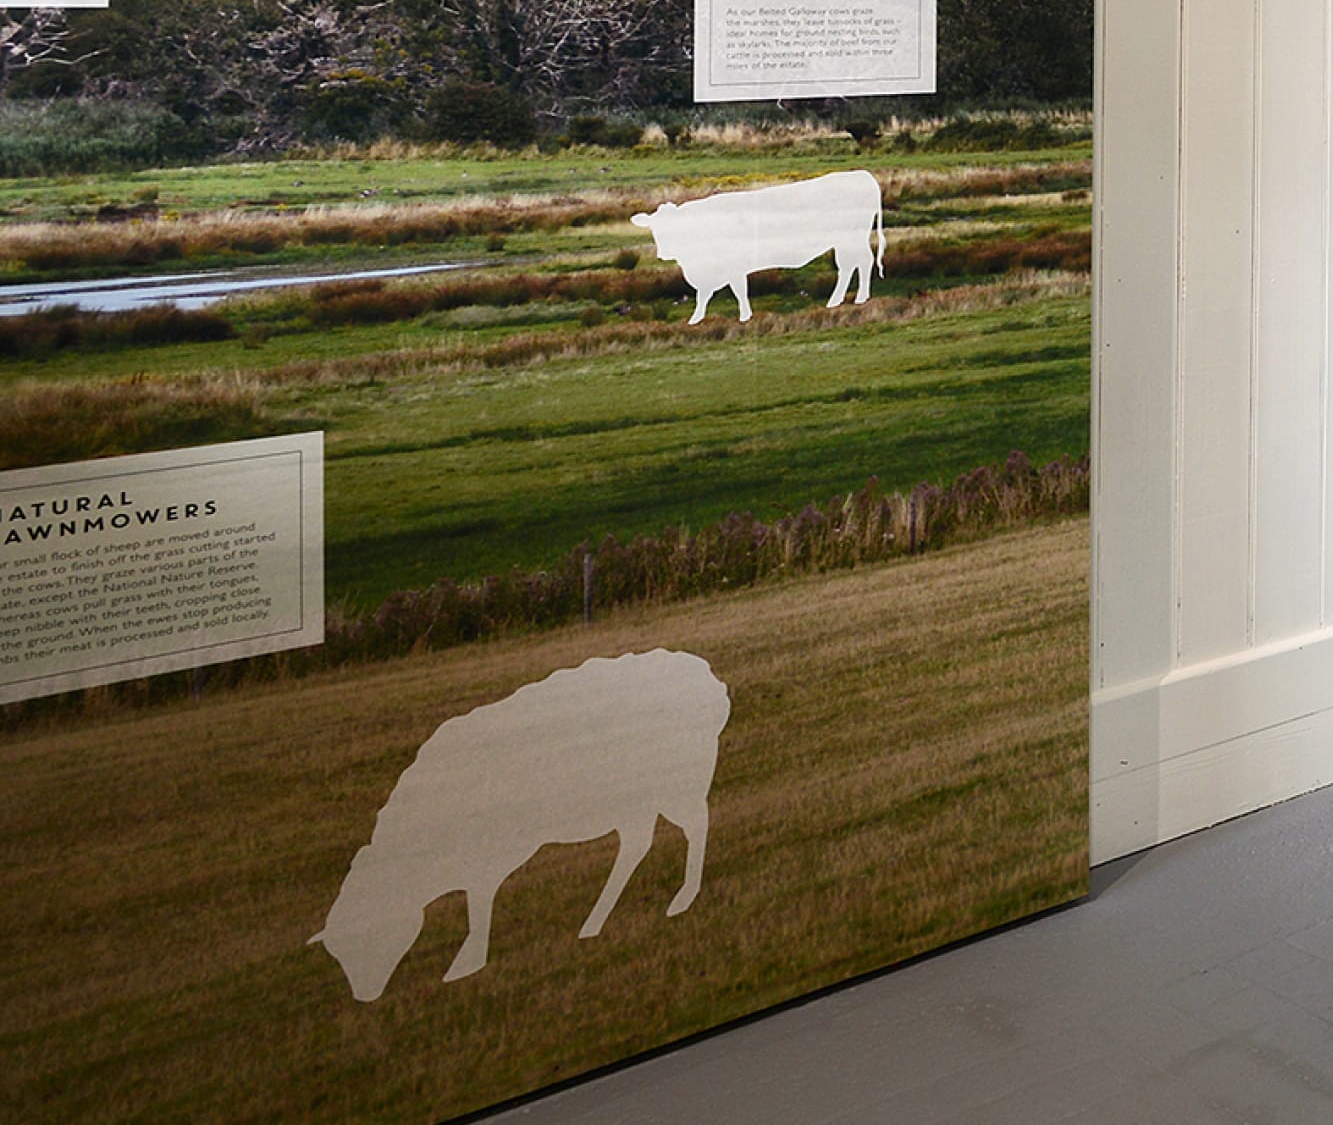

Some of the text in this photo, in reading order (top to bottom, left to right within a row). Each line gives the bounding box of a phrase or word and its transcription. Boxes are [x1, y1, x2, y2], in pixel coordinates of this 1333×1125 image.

[0, 491, 133, 523] ATURAL
[3, 500, 216, 546] AWNMOWERS
[13, 554, 46, 567] small
[50, 549, 81, 561] flock
[85, 546, 100, 555] of
[104, 540, 140, 555] sheep
[144, 538, 164, 546] are
[168, 529, 209, 543] moved
[214, 522, 255, 535] around
